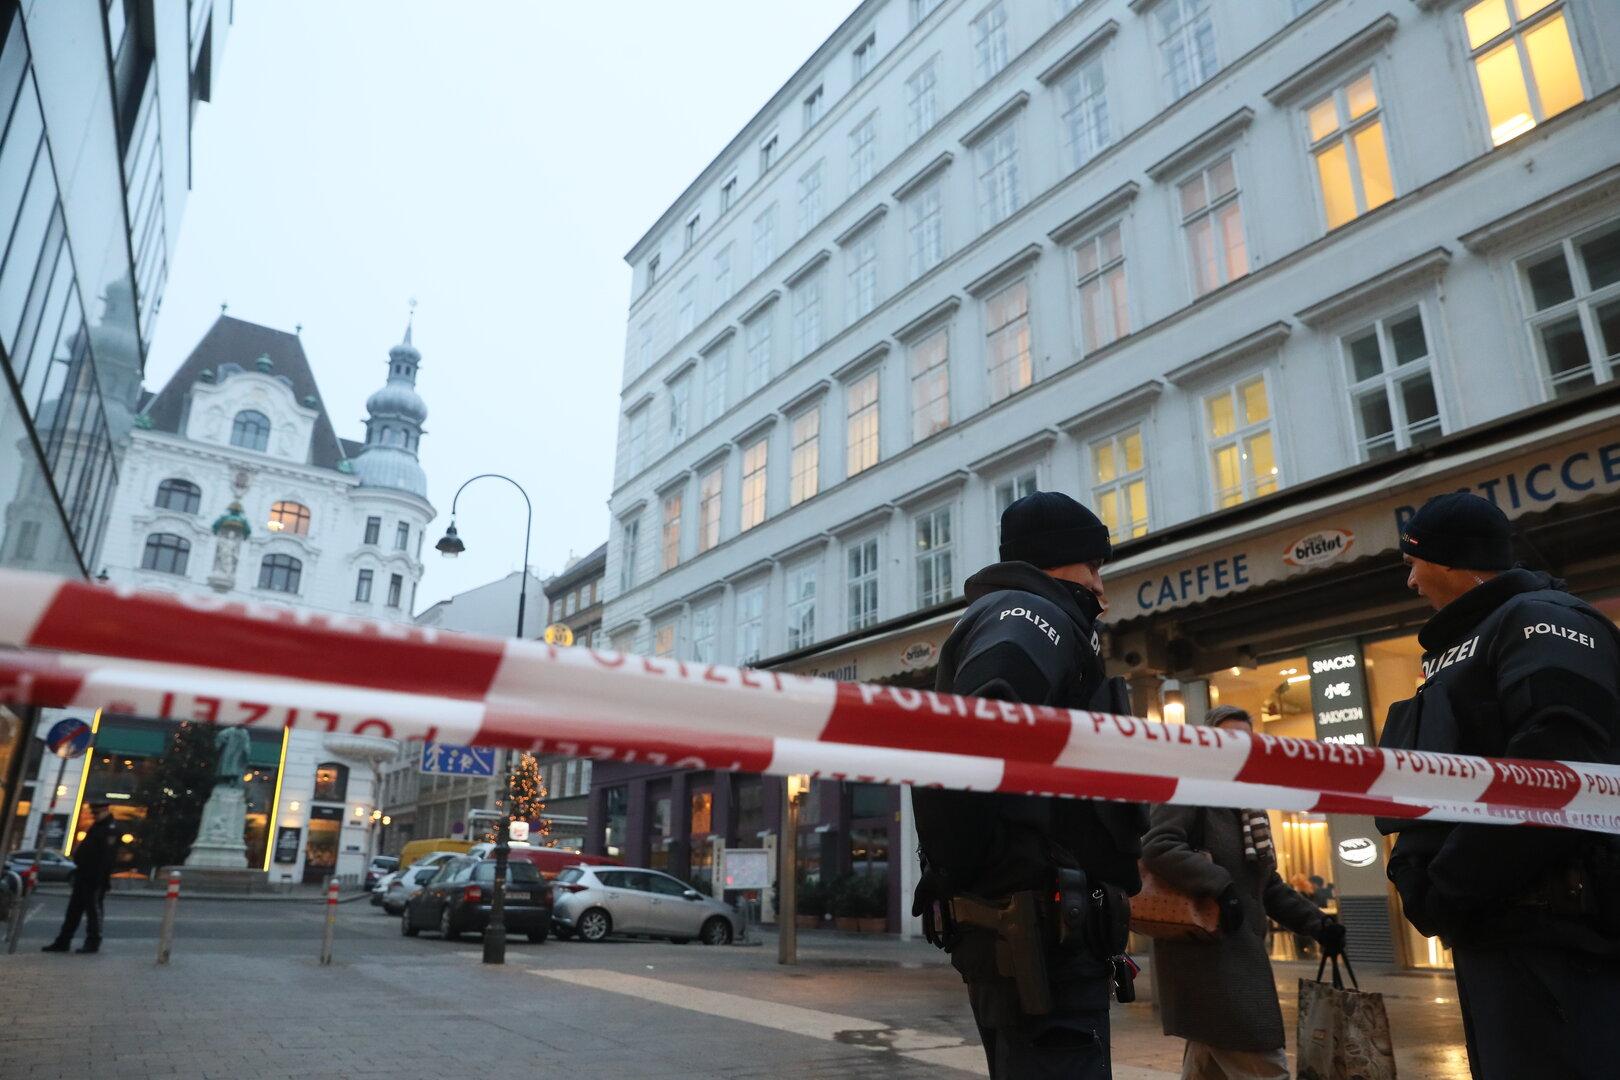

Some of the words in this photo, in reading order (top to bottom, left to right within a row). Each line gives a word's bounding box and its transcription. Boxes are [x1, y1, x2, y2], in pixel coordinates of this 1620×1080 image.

[1394, 443, 1620, 534] PTICCE
[1295, 534, 1343, 560] bristot
[1137, 553, 1249, 610] CAFFEE
[1000, 607, 1061, 646] POLIZEI
[1523, 622, 1595, 649] POLIZEI
[1312, 654, 1356, 674] SNACKS
[1422, 635, 1480, 680] OLIZEI
[857, 684, 1036, 726] POLIZEI
[1088, 711, 1222, 748] POLIZEI
[1260, 733, 1364, 766] POLIZEI
[1391, 750, 1476, 779] POLIZEI
[1495, 761, 1567, 790] POLIZEI
